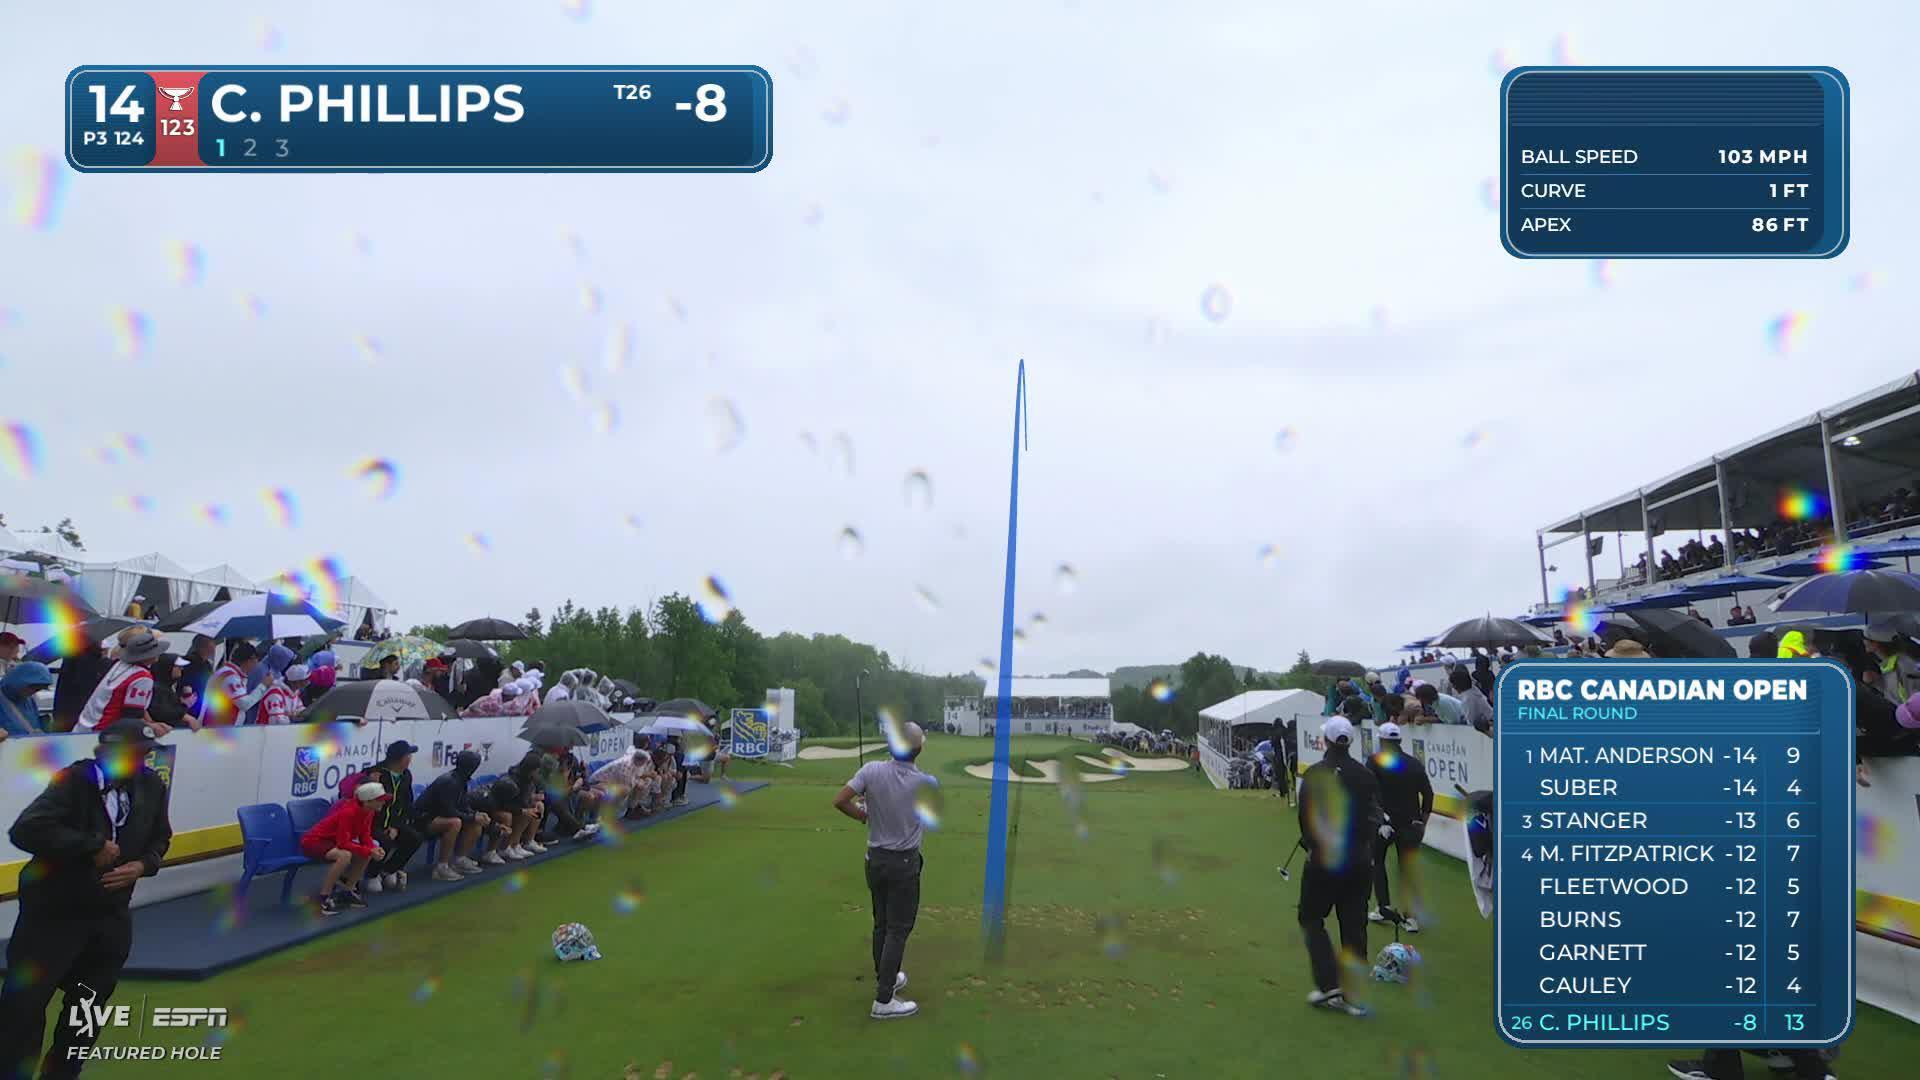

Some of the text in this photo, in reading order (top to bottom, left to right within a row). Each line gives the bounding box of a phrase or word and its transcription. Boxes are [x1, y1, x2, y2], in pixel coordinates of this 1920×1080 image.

[600, 737, 625, 753] OPEN
[734, 742, 767, 754] RBC
[1427, 739, 1467, 757] CANADIAN
[1427, 758, 1469, 783] OPEN
[294, 783, 317, 794] RBC
